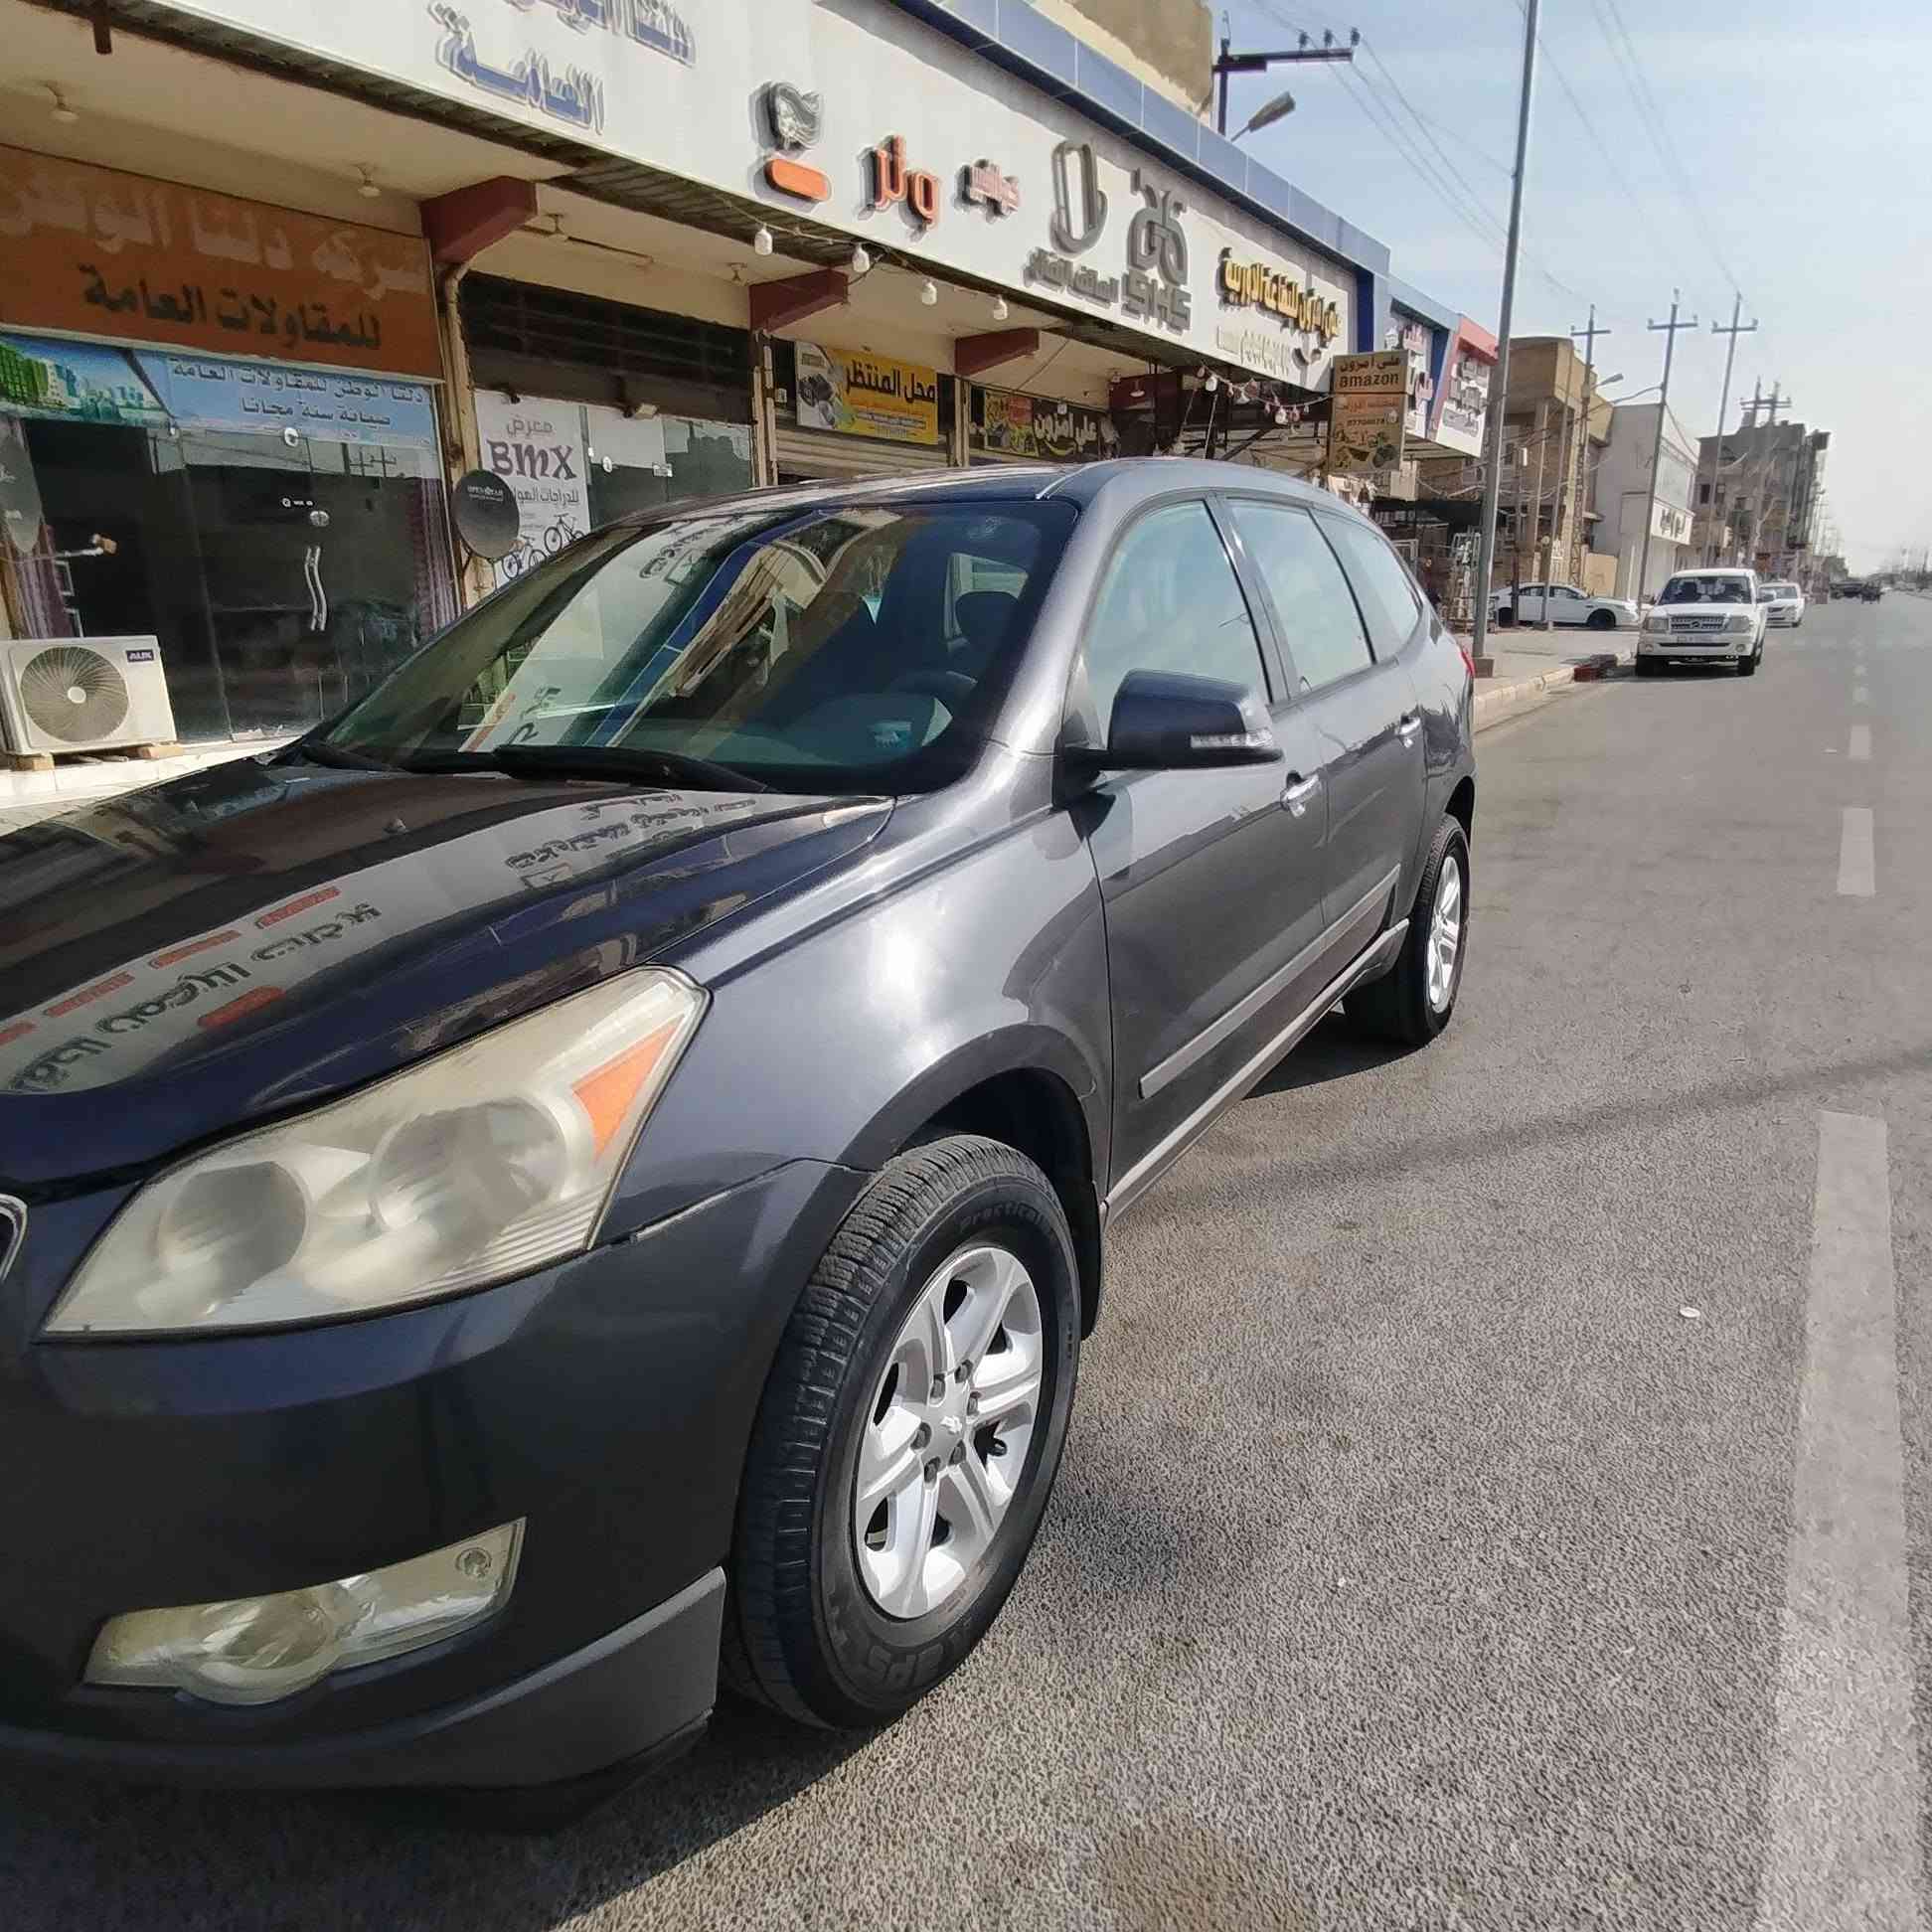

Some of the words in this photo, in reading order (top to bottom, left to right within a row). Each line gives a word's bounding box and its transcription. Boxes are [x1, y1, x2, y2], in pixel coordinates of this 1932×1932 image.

[78, 262, 207, 324] العامة
[216, 286, 382, 348] للمقاولات
[173, 358, 234, 382] العامة
[241, 368, 328, 393] للمقاولات
[846, 360, 901, 398] المنتظر
[1339, 373, 1399, 389] amazon
[903, 373, 937, 404] محل
[242, 398, 294, 419] مجانا
[298, 400, 335, 422] سنة
[506, 414, 554, 437] معرض
[129, 651, 152, 661] AUX
